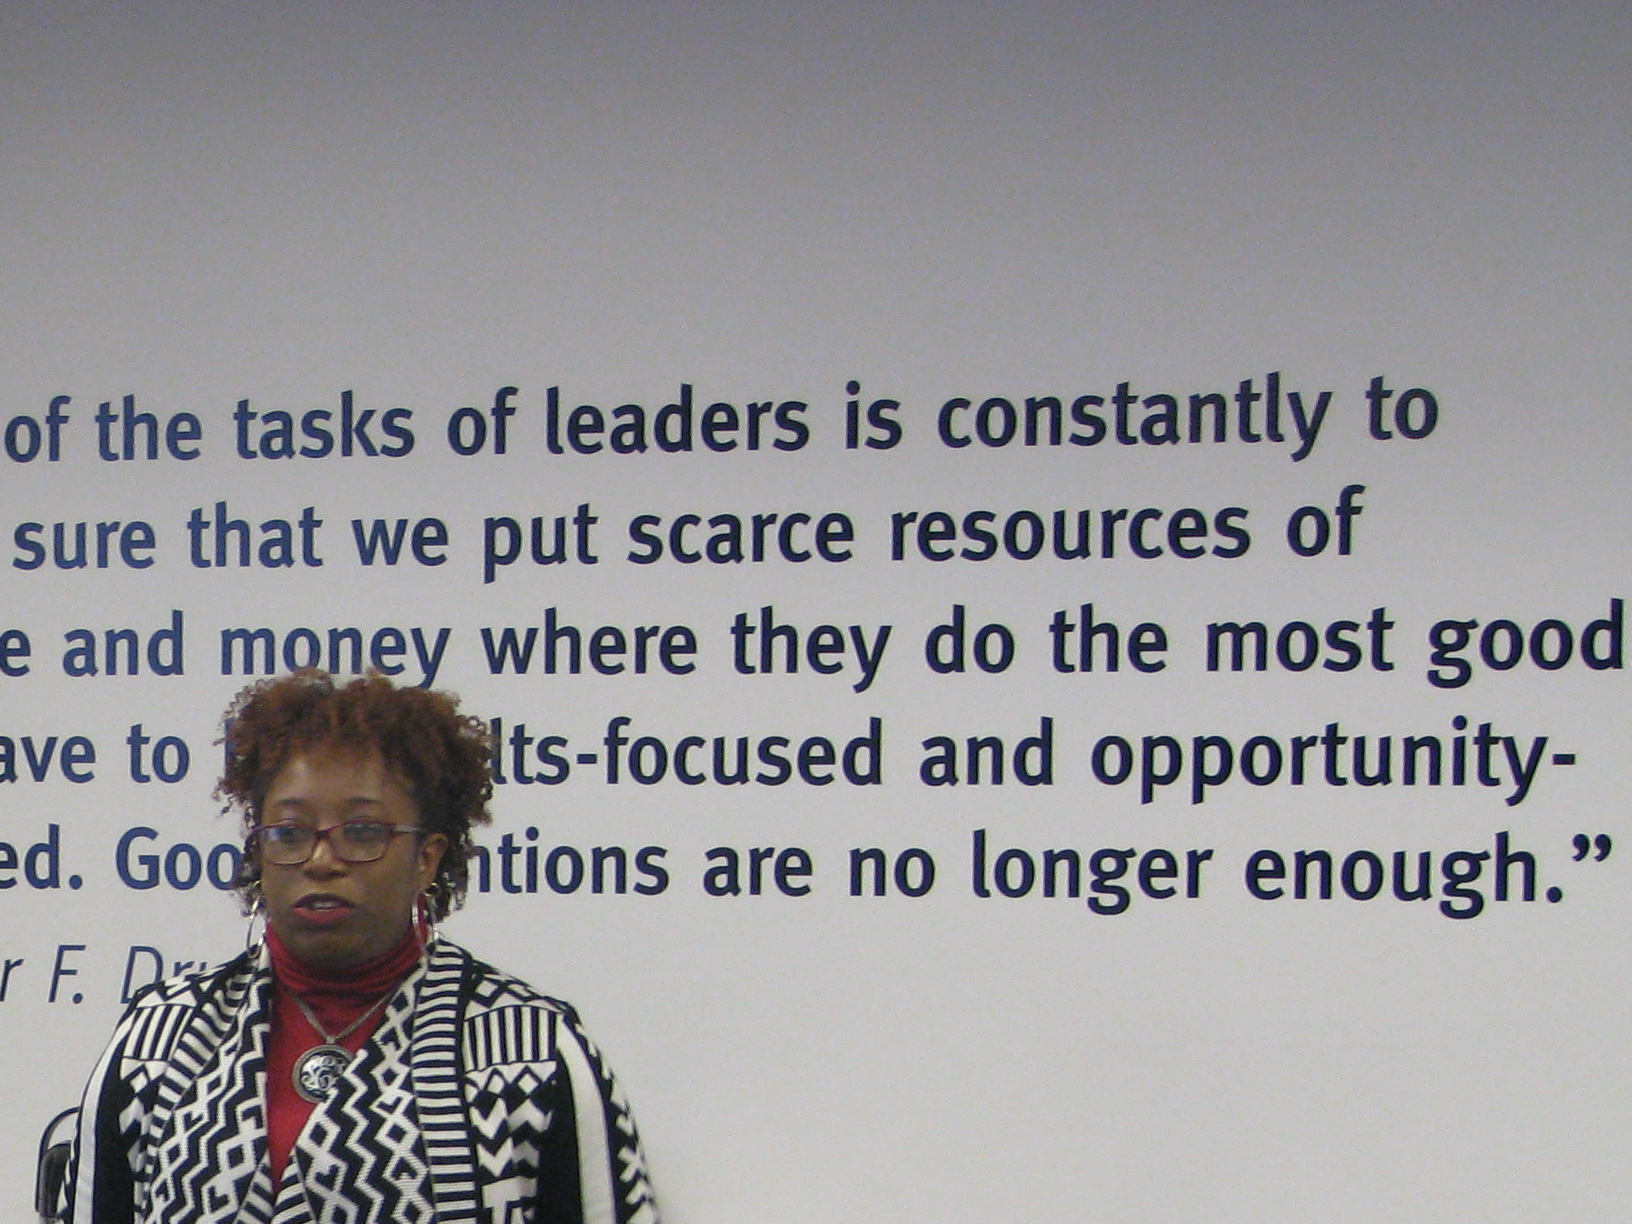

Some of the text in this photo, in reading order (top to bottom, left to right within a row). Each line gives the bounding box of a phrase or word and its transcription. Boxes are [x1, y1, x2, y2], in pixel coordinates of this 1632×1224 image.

[5, 395, 71, 463] of
[95, 394, 201, 461] the
[233, 390, 414, 459] tasks
[448, 386, 518, 455] of
[547, 384, 809, 454] leaders
[846, 380, 902, 449] is
[938, 371, 1333, 462] constantly
[1366, 376, 1438, 440] to
[13, 522, 155, 570] sure
[188, 501, 323, 568] that
[352, 518, 448, 566] we
[485, 503, 598, 584] put
[628, 513, 854, 564] scarce
[892, 507, 1250, 561] resources
[1287, 485, 1366, 557] of
[63, 610, 183, 677] and
[221, 627, 452, 690] money
[481, 607, 696, 675] where
[731, 606, 892, 693] they
[926, 604, 1014, 674] do
[1049, 603, 1167, 673] the
[1207, 608, 1394, 672] most
[1428, 598, 1624, 688] good
[127, 724, 189, 783] to
[490, 717, 881, 786] lts-focused
[920, 717, 1053, 786] and
[1092, 715, 1575, 806] opportunity-
[116, 827, 240, 890] Goo
[470, 826, 668, 895] ntions
[704, 847, 812, 896] are
[850, 848, 935, 897] no
[973, 829, 1213, 915] longer
[1246, 831, 1611, 919] enough.”
[48, 944, 86, 1005] F.
